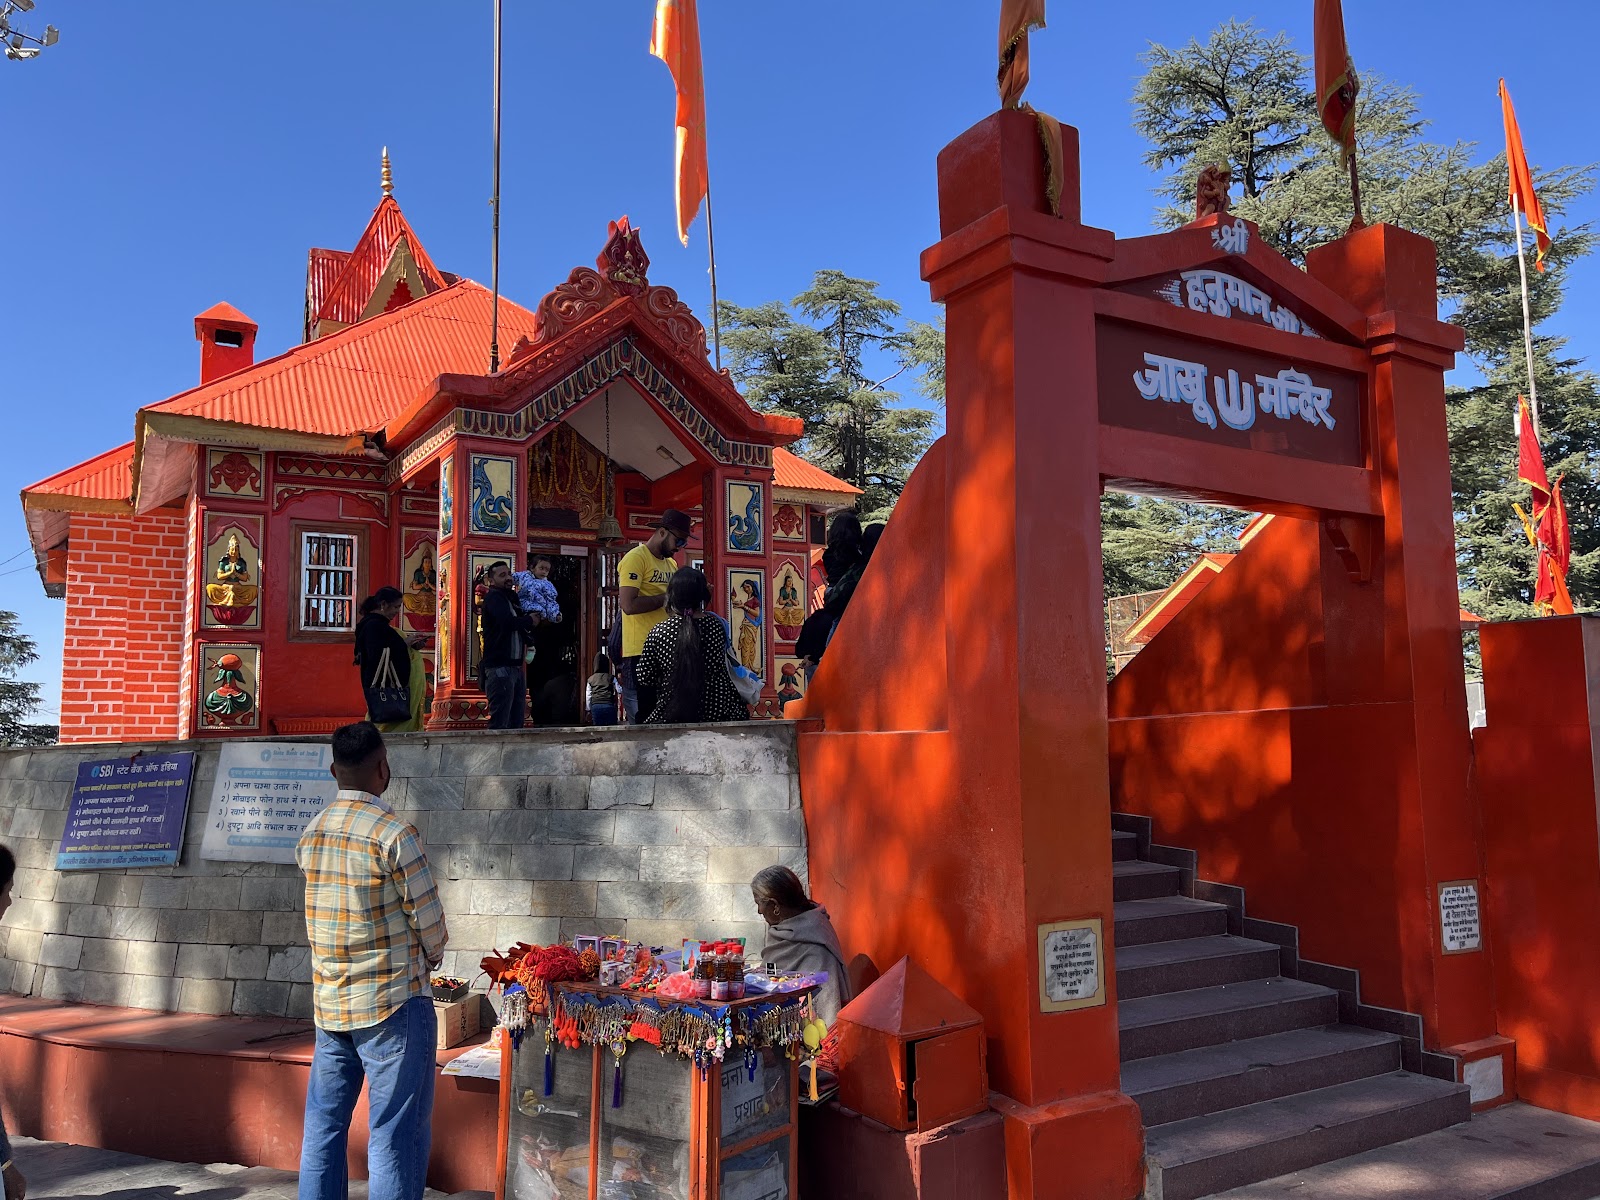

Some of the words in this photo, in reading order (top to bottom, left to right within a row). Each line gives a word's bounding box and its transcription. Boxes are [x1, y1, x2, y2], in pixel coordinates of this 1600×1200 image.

[1218, 218, 1249, 254] श्री
[1180, 270, 1272, 322] हनुमान
[1133, 352, 1218, 429] जाखू
[1256, 367, 1336, 431] मन्दिर
[99, 765, 115, 778] SBI
[117, 765, 129, 775] स्टेट
[131, 764, 143, 774] बैंक
[145, 762, 159, 773] ऑफ
[161, 761, 178, 772] इंडिया
[233, 782, 251, 790] अपना
[274, 783, 290, 791] उतार
[233, 793, 257, 803] मोबाइल
[260, 794, 274, 804] फोन
[82, 807, 102, 816] मोबाइल
[231, 807, 246, 817] खाने
[249, 808, 260, 817] पीने
[264, 808, 272, 818] की
[298, 811, 312, 819] हाथ
[216, 820, 225, 830] 4)
[227, 823, 244, 833] दुपट्टा
[247, 821, 262, 831] आदि
[264, 822, 284, 831] संभाल
